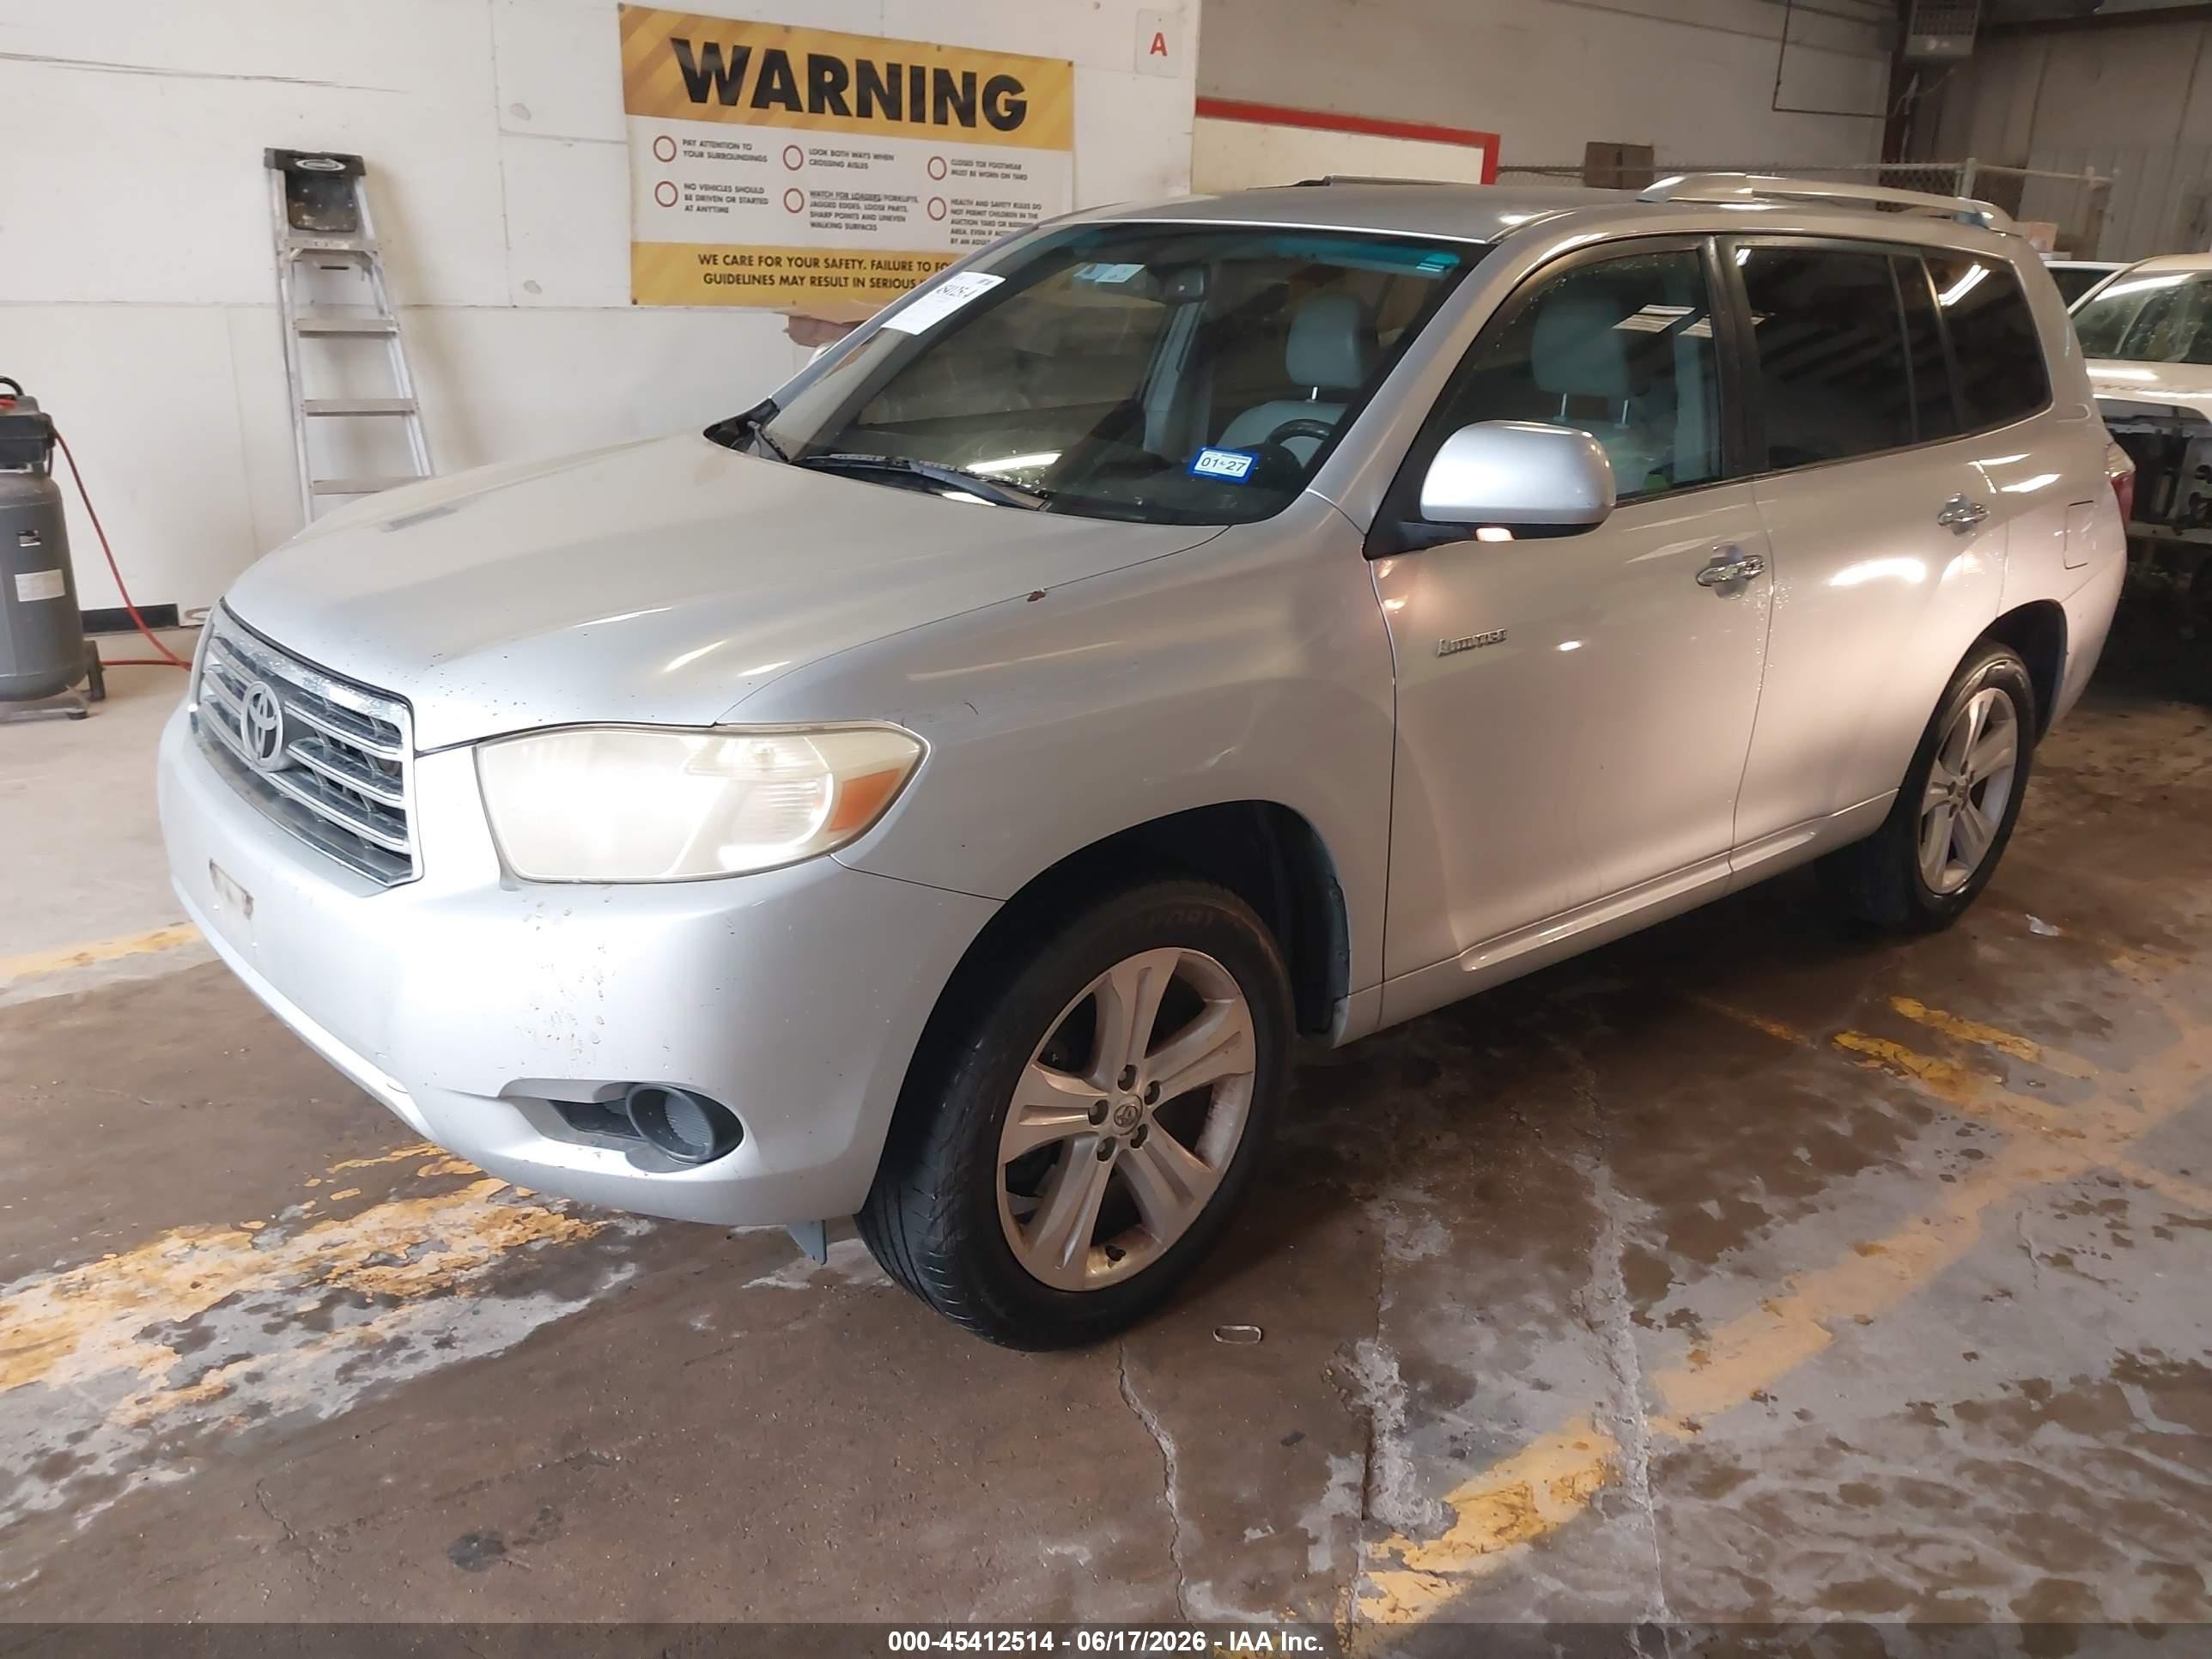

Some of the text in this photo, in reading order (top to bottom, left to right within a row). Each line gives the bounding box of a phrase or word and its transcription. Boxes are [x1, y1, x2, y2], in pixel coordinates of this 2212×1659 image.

[1150, 32, 1168, 57] A
[670, 37, 1028, 131] WARNING
[699, 140, 740, 149] ATTENTION
[707, 152, 768, 163] SURROUNDINGS
[809, 148, 894, 161] LOOK BOTH WAYS WHEN
[809, 159, 869, 170] CROSSING AISLES
[988, 161, 1022, 171] FOOTWEAR
[1012, 173, 1028, 181] YARD
[699, 184, 732, 193] VEHICLES
[696, 194, 723, 203] DRIVEN
[739, 197, 769, 205] STARTED
[810, 191, 834, 199] WATCH
[836, 191, 849, 200] FOR
[810, 201, 836, 210] JAGGED
[864, 204, 885, 212] LOOSE
[975, 199, 988, 208] AND
[991, 201, 1012, 210] SAFETY
[835, 212, 860, 221] POINTS
[861, 213, 877, 222] AND
[879, 214, 906, 223] UNEVEN
[988, 210, 1018, 219] CHILDREN
[810, 222, 878, 232] WALKING SURFACES
[951, 218, 978, 227] AUCTION
[698, 254, 718, 265] WE
[723, 254, 753, 267] CARE
[758, 256, 782, 268] FOR
[787, 257, 819, 269] YOUR
[824, 258, 866, 270] SAFETY.
[871, 259, 914, 272] FAILURE
[916, 261, 932, 272] TO
[703, 273, 775, 286] GUIDELINES
[779, 275, 805, 286] MAY
[810, 276, 848, 288] RESULT
[854, 277, 866, 288] IN
[869, 277, 916, 289] SERIOUS
